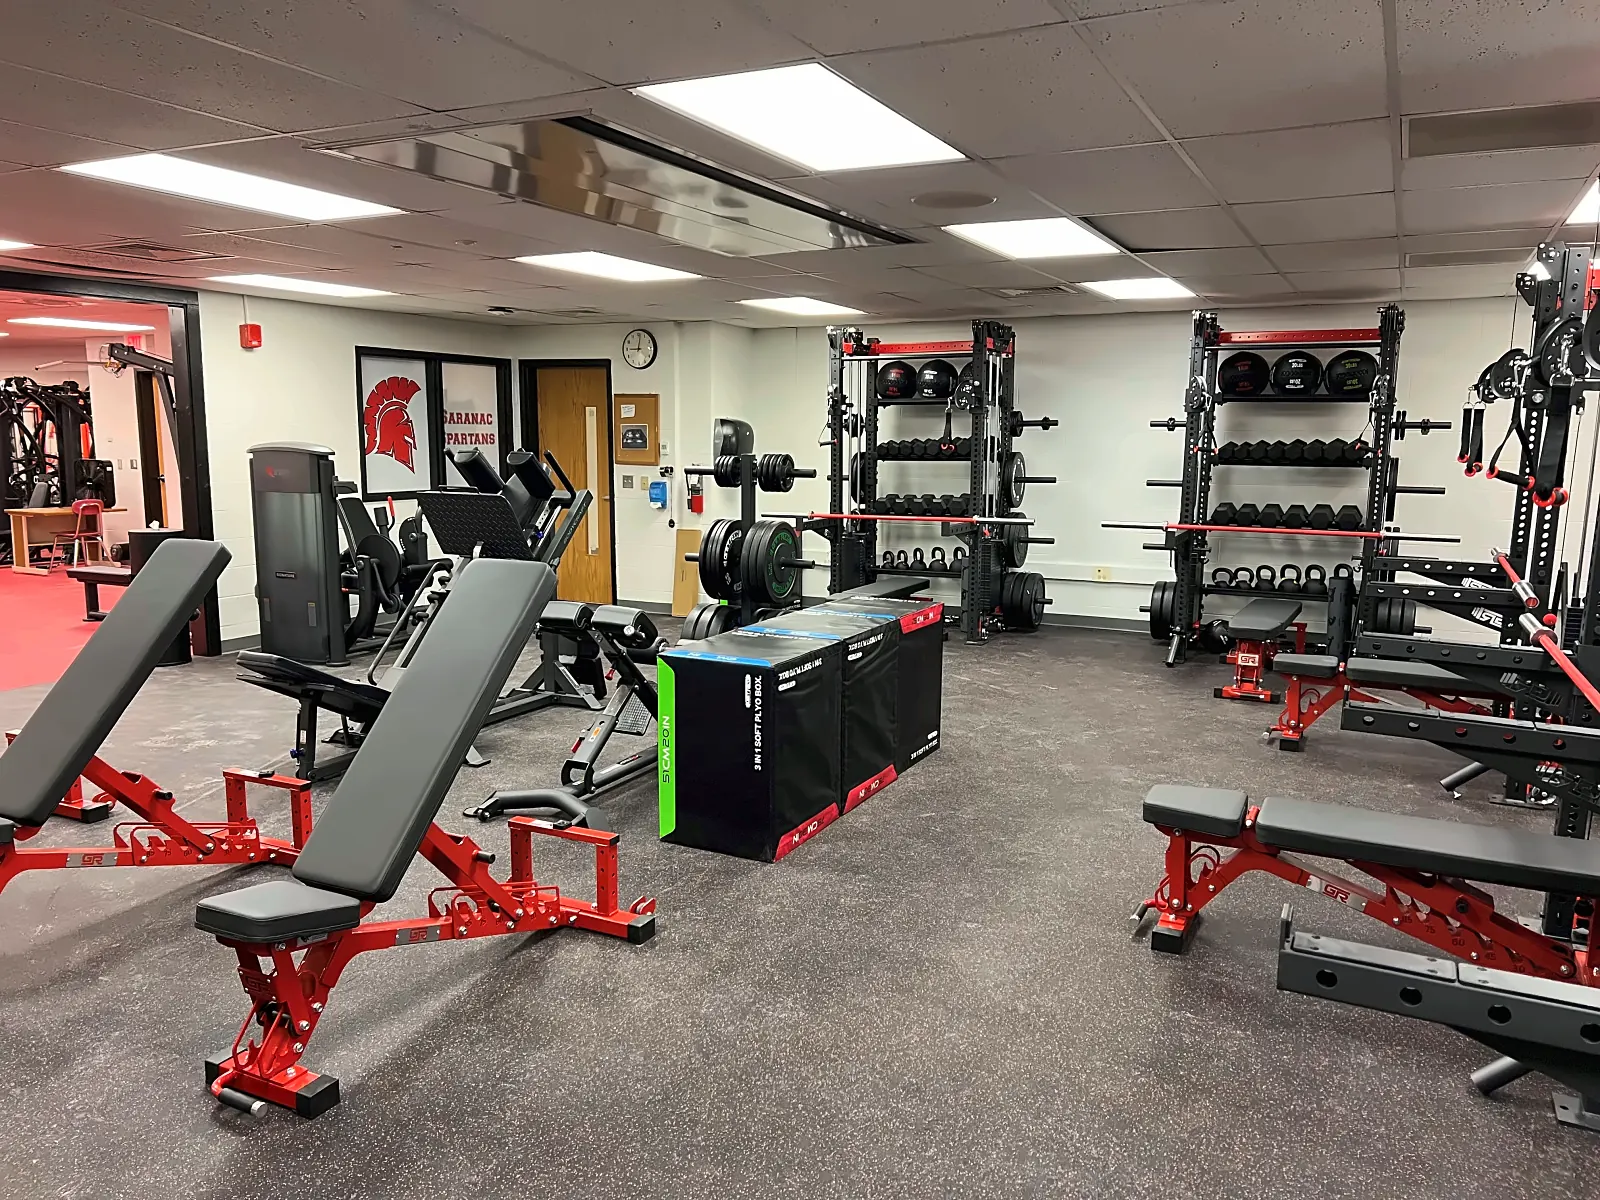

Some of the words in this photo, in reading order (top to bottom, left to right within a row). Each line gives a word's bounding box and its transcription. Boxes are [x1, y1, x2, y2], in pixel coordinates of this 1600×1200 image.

[445, 432, 496, 445] PARTANS
[754, 698, 762, 723] PLYO
[754, 723, 762, 748] SOFT
[754, 754, 762, 764] IN
[1425, 925, 1436, 934] 75
